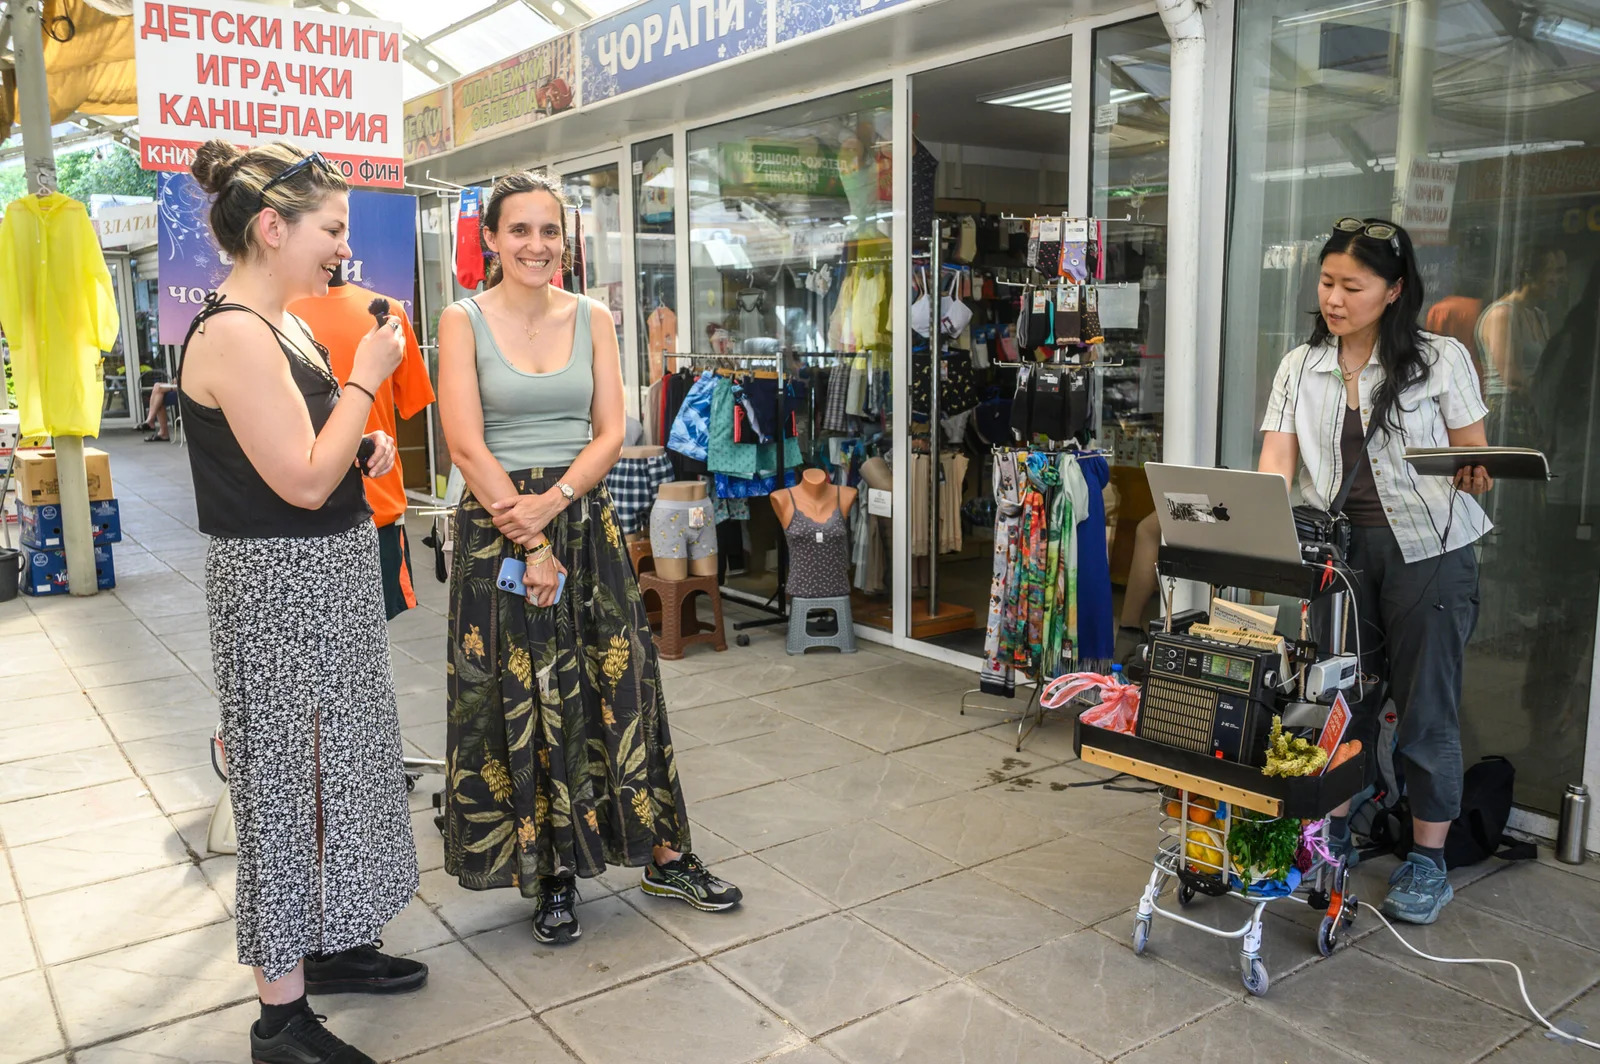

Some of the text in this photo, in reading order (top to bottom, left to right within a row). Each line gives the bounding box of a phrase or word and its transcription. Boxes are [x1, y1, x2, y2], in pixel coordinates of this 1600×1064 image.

[141, 2, 399, 63] ДЕТСКИ КНИГИ
[598, 0, 745, 75] ЧОРАПИ
[196, 53, 352, 99] ИГРАЧКИ
[462, 57, 544, 108] МЛАДЕЖКИ
[159, 93, 388, 143] КАНЦЕЛАРИЯ
[471, 87, 538, 131] ОБЛЕКЛА
[359, 159, 399, 182] ФИН
[168, 286, 217, 305] ЧО
